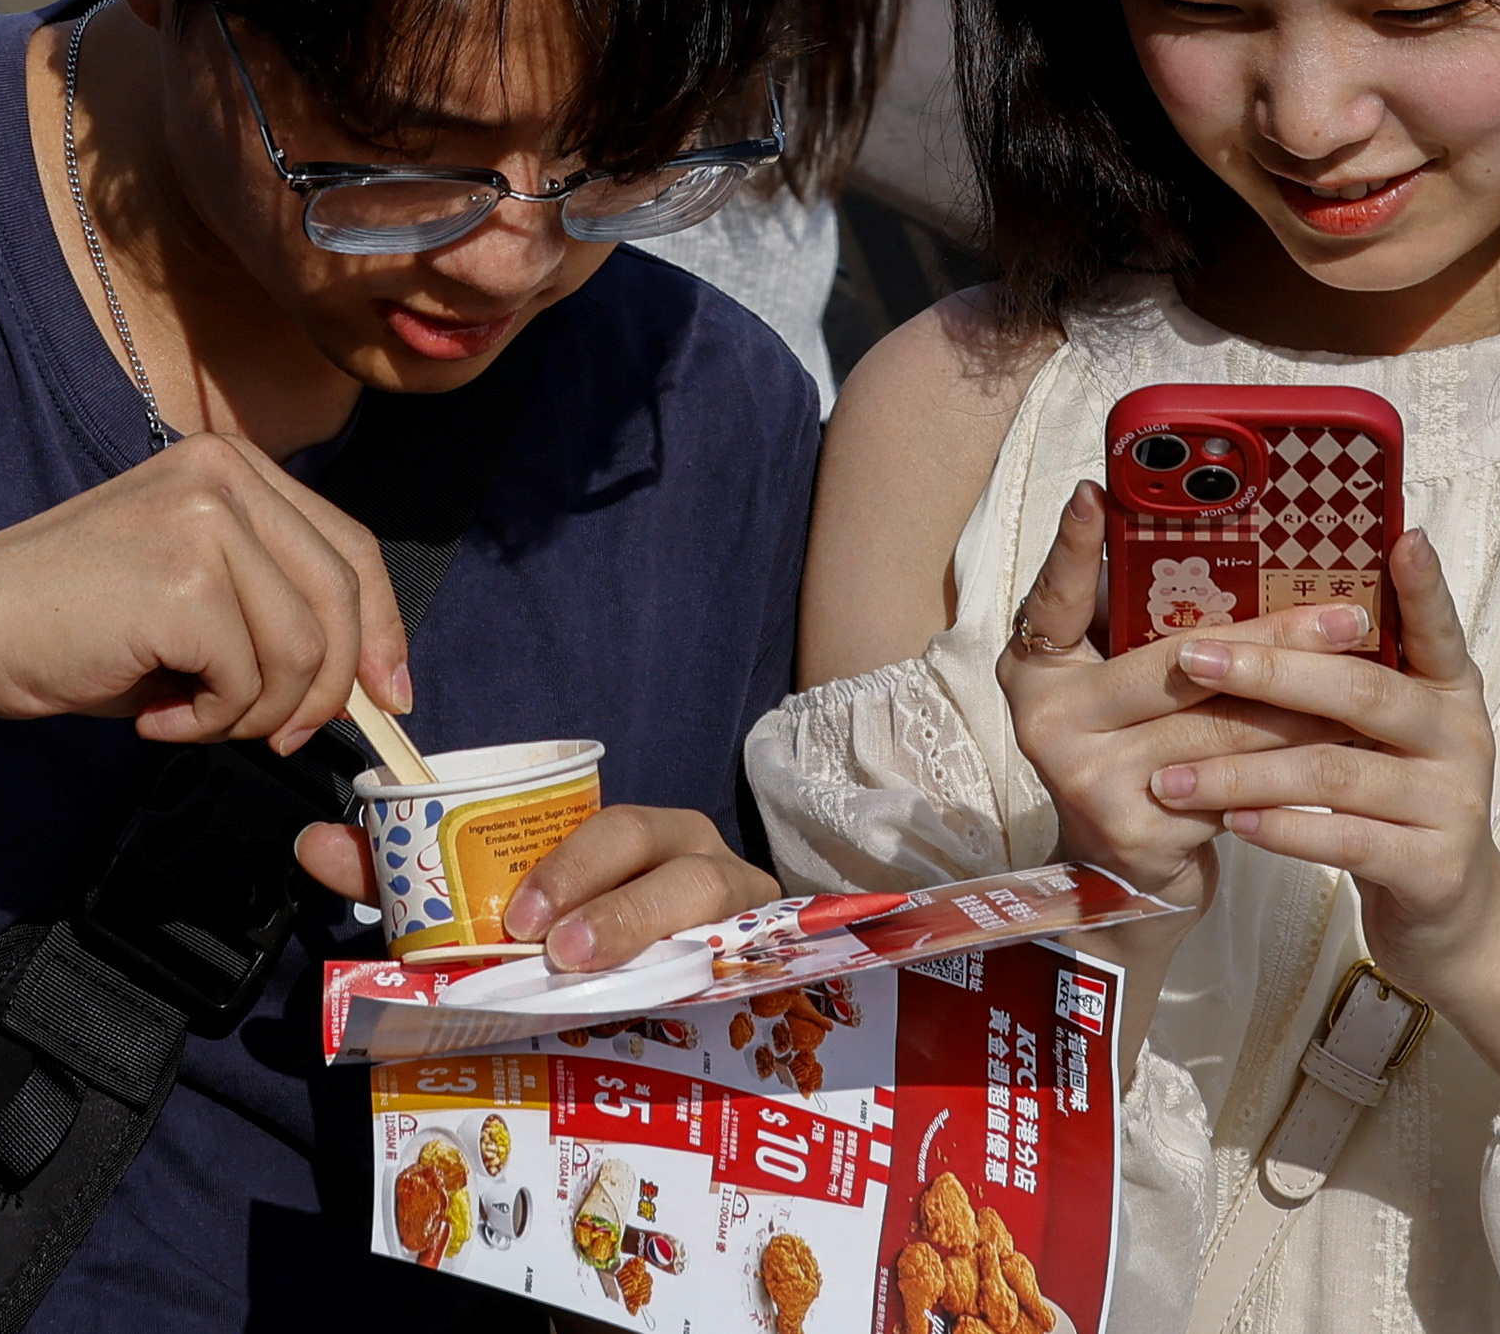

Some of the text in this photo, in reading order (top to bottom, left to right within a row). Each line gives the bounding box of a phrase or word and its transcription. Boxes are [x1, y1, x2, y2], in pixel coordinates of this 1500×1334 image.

[1112, 423, 1171, 456] GOOD LUCK
[1199, 485, 1258, 518] GOOD LUCK
[1172, 612, 1196, 627] 福
[469, 819, 518, 834] Ingredients:
[519, 814, 543, 826] Water,
[494, 847, 509, 858] Net
[511, 842, 540, 855] Volume:
[1058, 978, 1070, 1012] KFC
[1052, 1039, 1066, 1065] finger
[1068, 1032, 1089, 1113] 指嚐回味
[594, 1075, 650, 1124] $5
[985, 1006, 1011, 1188] 黃金週超值優惠
[1014, 1022, 1039, 1194] KFC 香港分店
[1053, 1087, 1069, 1117] good
[385, 1114, 396, 1151] 11:00AM
[811, 1119, 825, 1144] 只售
[559, 1139, 570, 1188] 11:00AM
[637, 1178, 659, 1223] 全新
[718, 1187, 733, 1240] 11:00AM
